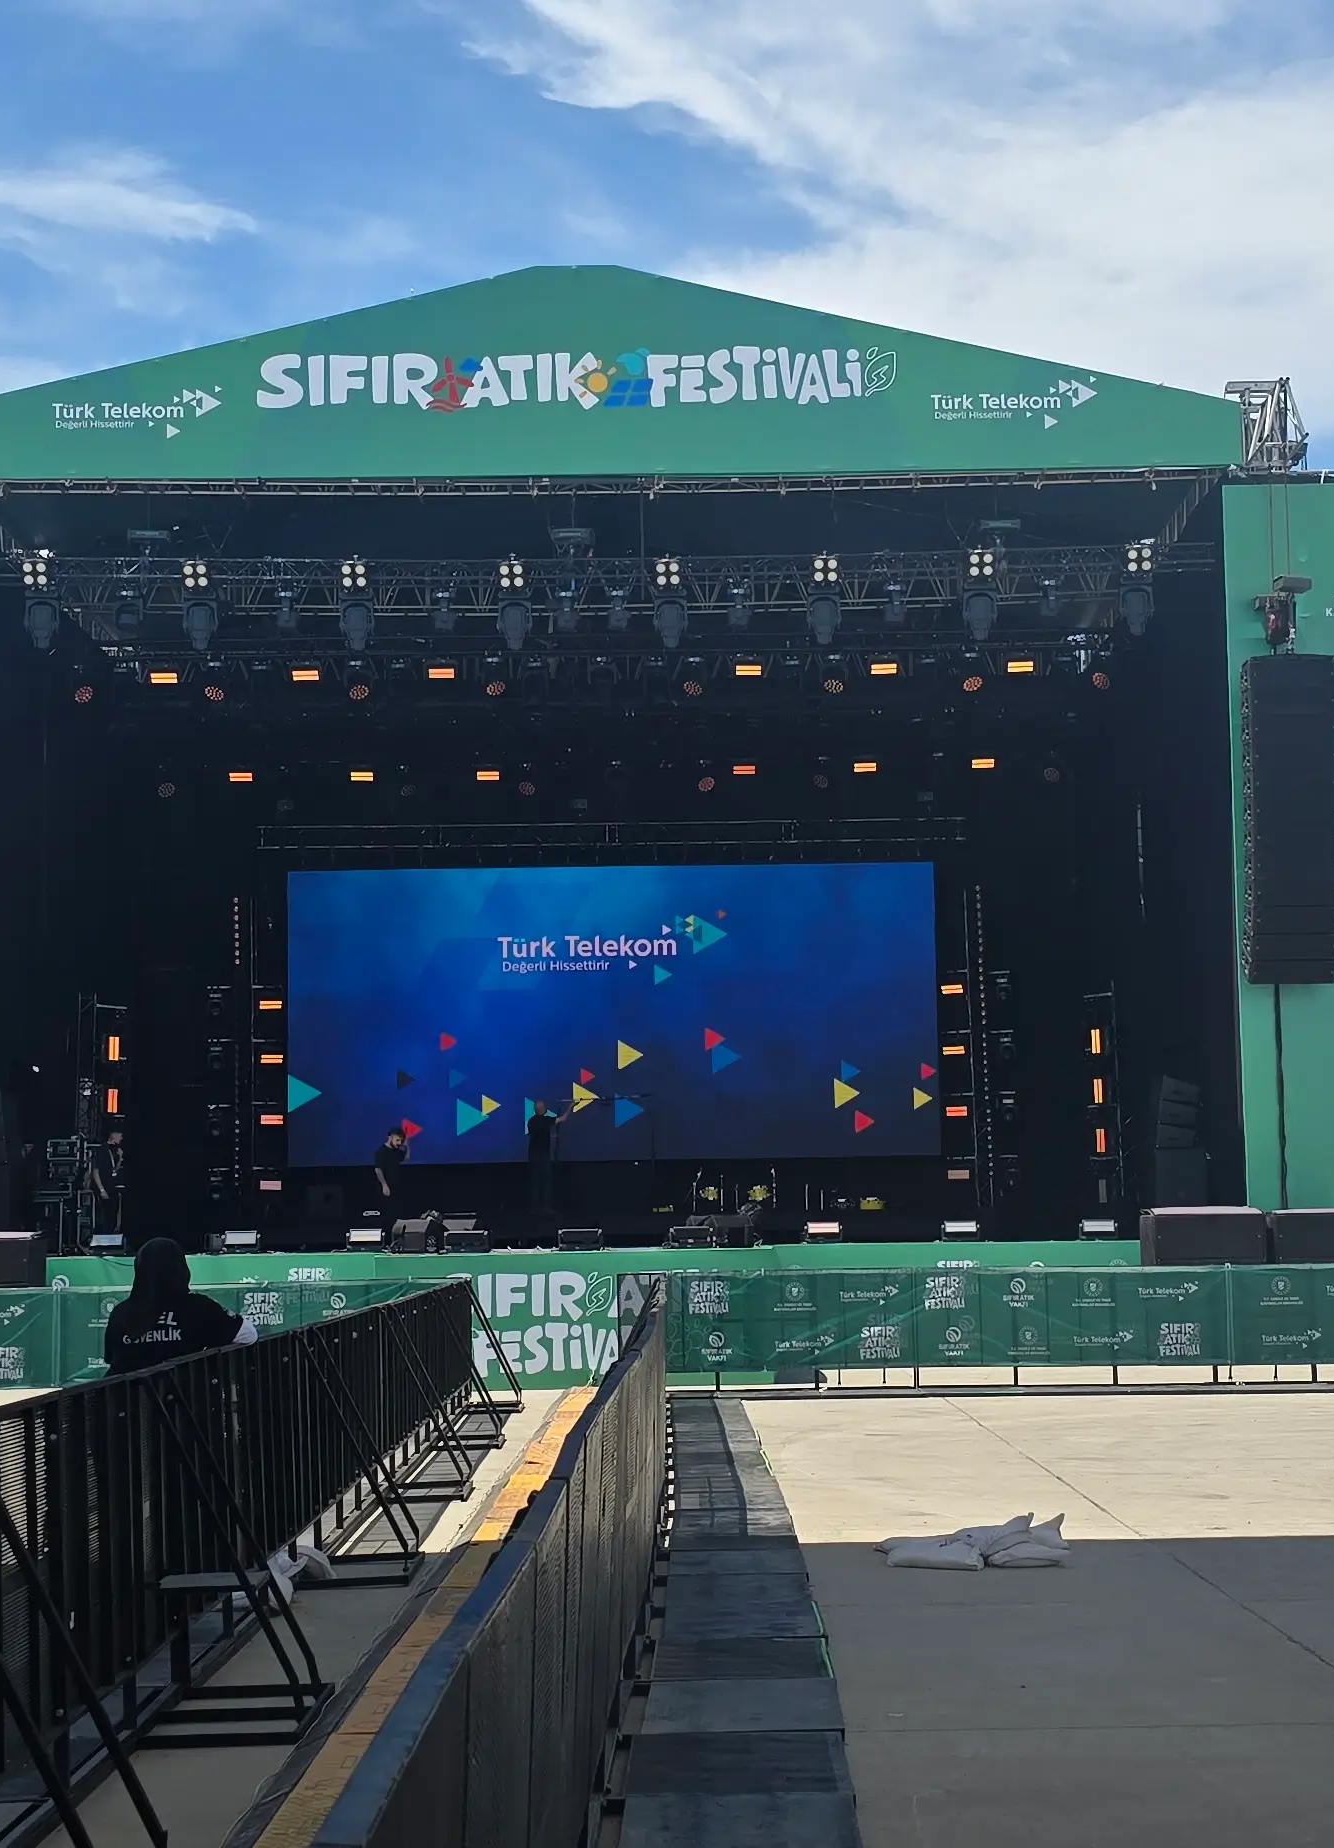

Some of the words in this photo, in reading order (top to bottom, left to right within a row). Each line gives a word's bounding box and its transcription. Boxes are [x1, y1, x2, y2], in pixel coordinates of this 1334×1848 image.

[256, 352, 436, 411] SIFIR
[466, 351, 599, 411] ATIK
[930, 393, 974, 410] Türk
[978, 393, 1062, 410] Telekom
[52, 402, 97, 419] Türk
[101, 402, 184, 419] Telekom
[934, 411, 967, 421] Değerli
[968, 410, 1013, 419] Hissettirir
[55, 419, 88, 431] Değerli
[90, 419, 135, 429] Hissettirir
[497, 935, 556, 958] Türk
[565, 934, 677, 958] Telekom
[502, 960, 546, 974] Değerli
[549, 959, 610, 971] Hissettirir
[690, 1280, 725, 1293] SIFIR
[925, 1276, 959, 1289] SIFIR
[839, 1291, 855, 1299] Türk
[857, 1290, 886, 1298] Telekom
[929, 1288, 956, 1298] ATIK
[1138, 1287, 1154, 1295] Türk
[1156, 1286, 1186, 1294] Telekom
[244, 1292, 279, 1303] SIFIR
[693, 1293, 720, 1302] ATIK
[247, 1304, 274, 1313] ATIK
[861, 1326, 897, 1338] SIFIR
[1160, 1322, 1194, 1335] SIFIR
[865, 1338, 888, 1348] ATIK
[1090, 1335, 1121, 1343] Telekom
[1163, 1334, 1191, 1345] ATIK
[1261, 1334, 1277, 1342] Türk
[1278, 1333, 1309, 1342] Telekom
